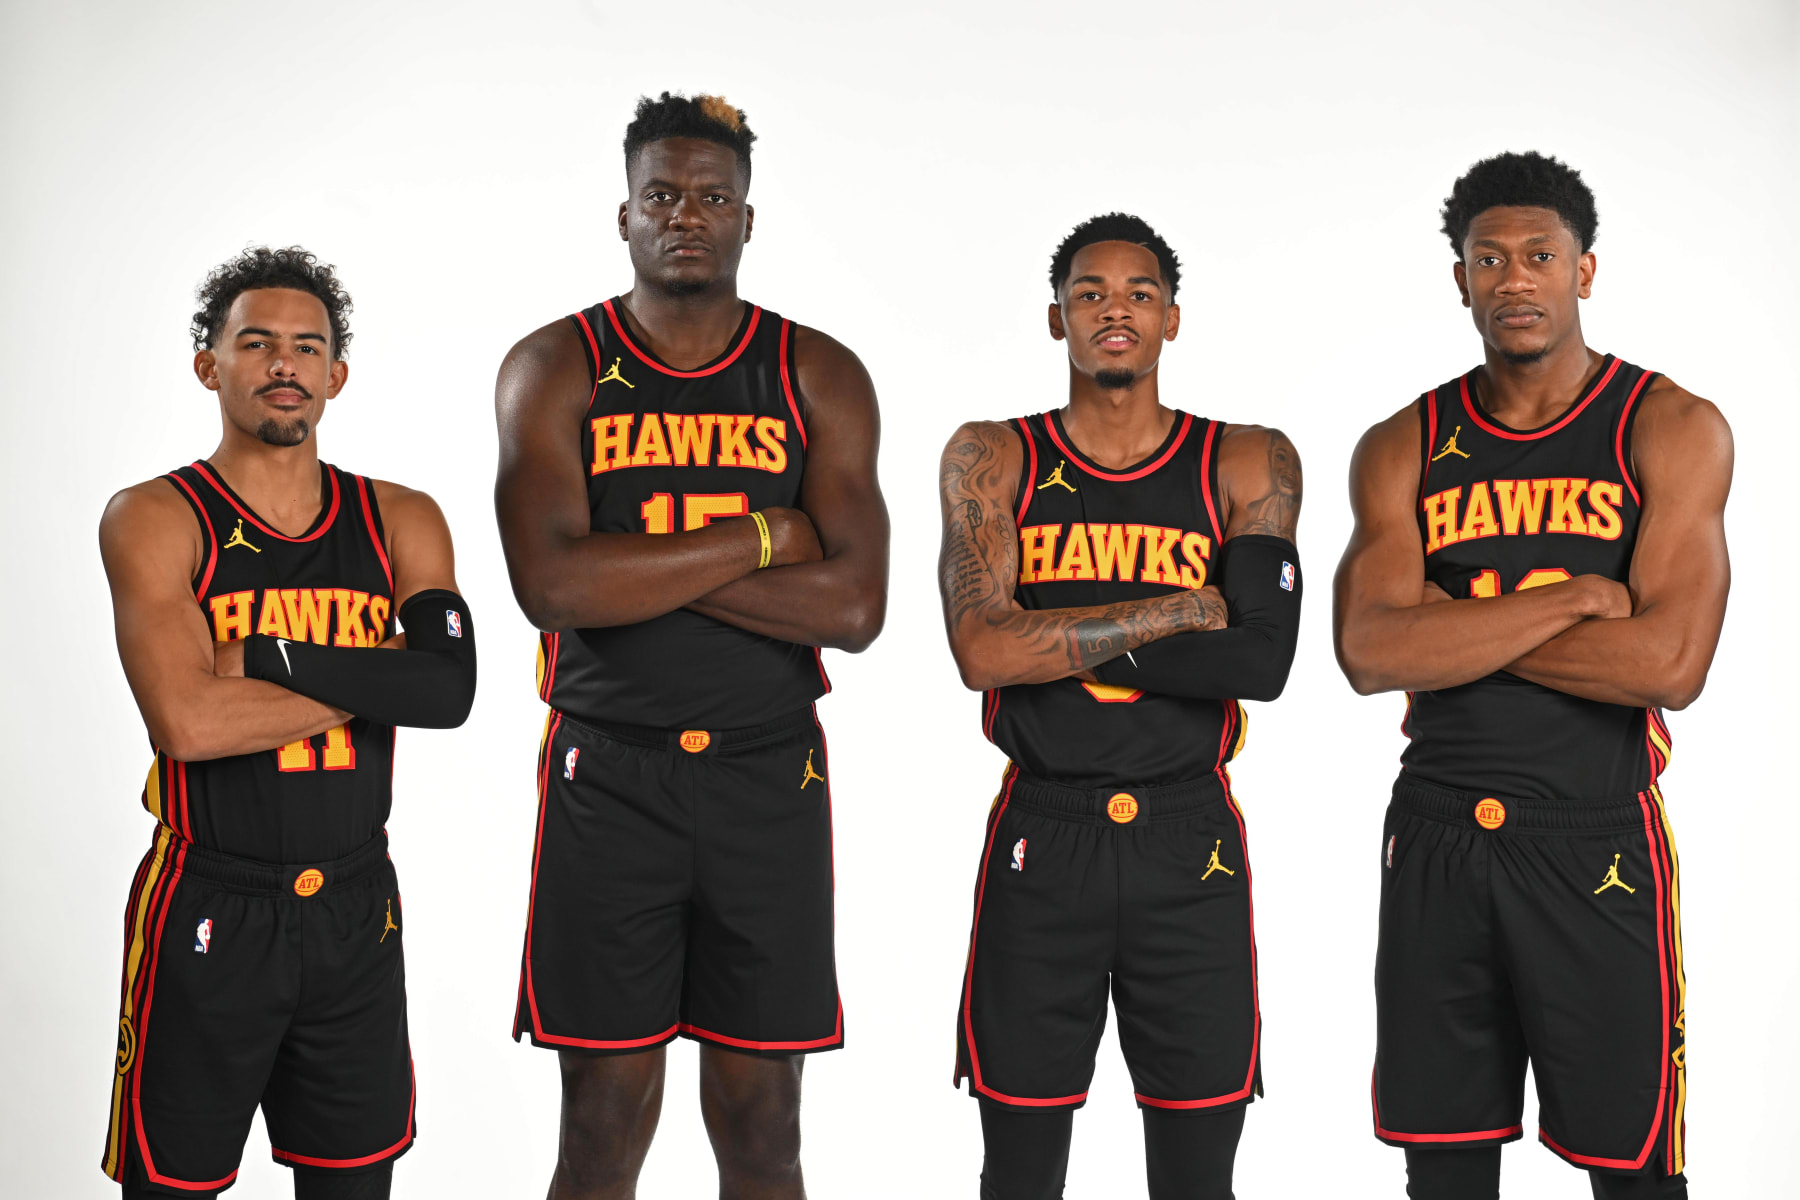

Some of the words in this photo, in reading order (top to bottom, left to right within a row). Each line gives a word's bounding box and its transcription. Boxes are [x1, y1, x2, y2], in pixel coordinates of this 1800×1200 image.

[591, 413, 787, 476] HAWKS
[1424, 478, 1623, 555] HAWKS
[1019, 523, 1211, 590] HAWKS
[209, 588, 391, 648] HAWKS
[683, 734, 705, 746] ATL
[1112, 802, 1134, 814] ATL
[1479, 806, 1501, 821] ATL
[298, 877, 319, 889] ATL
